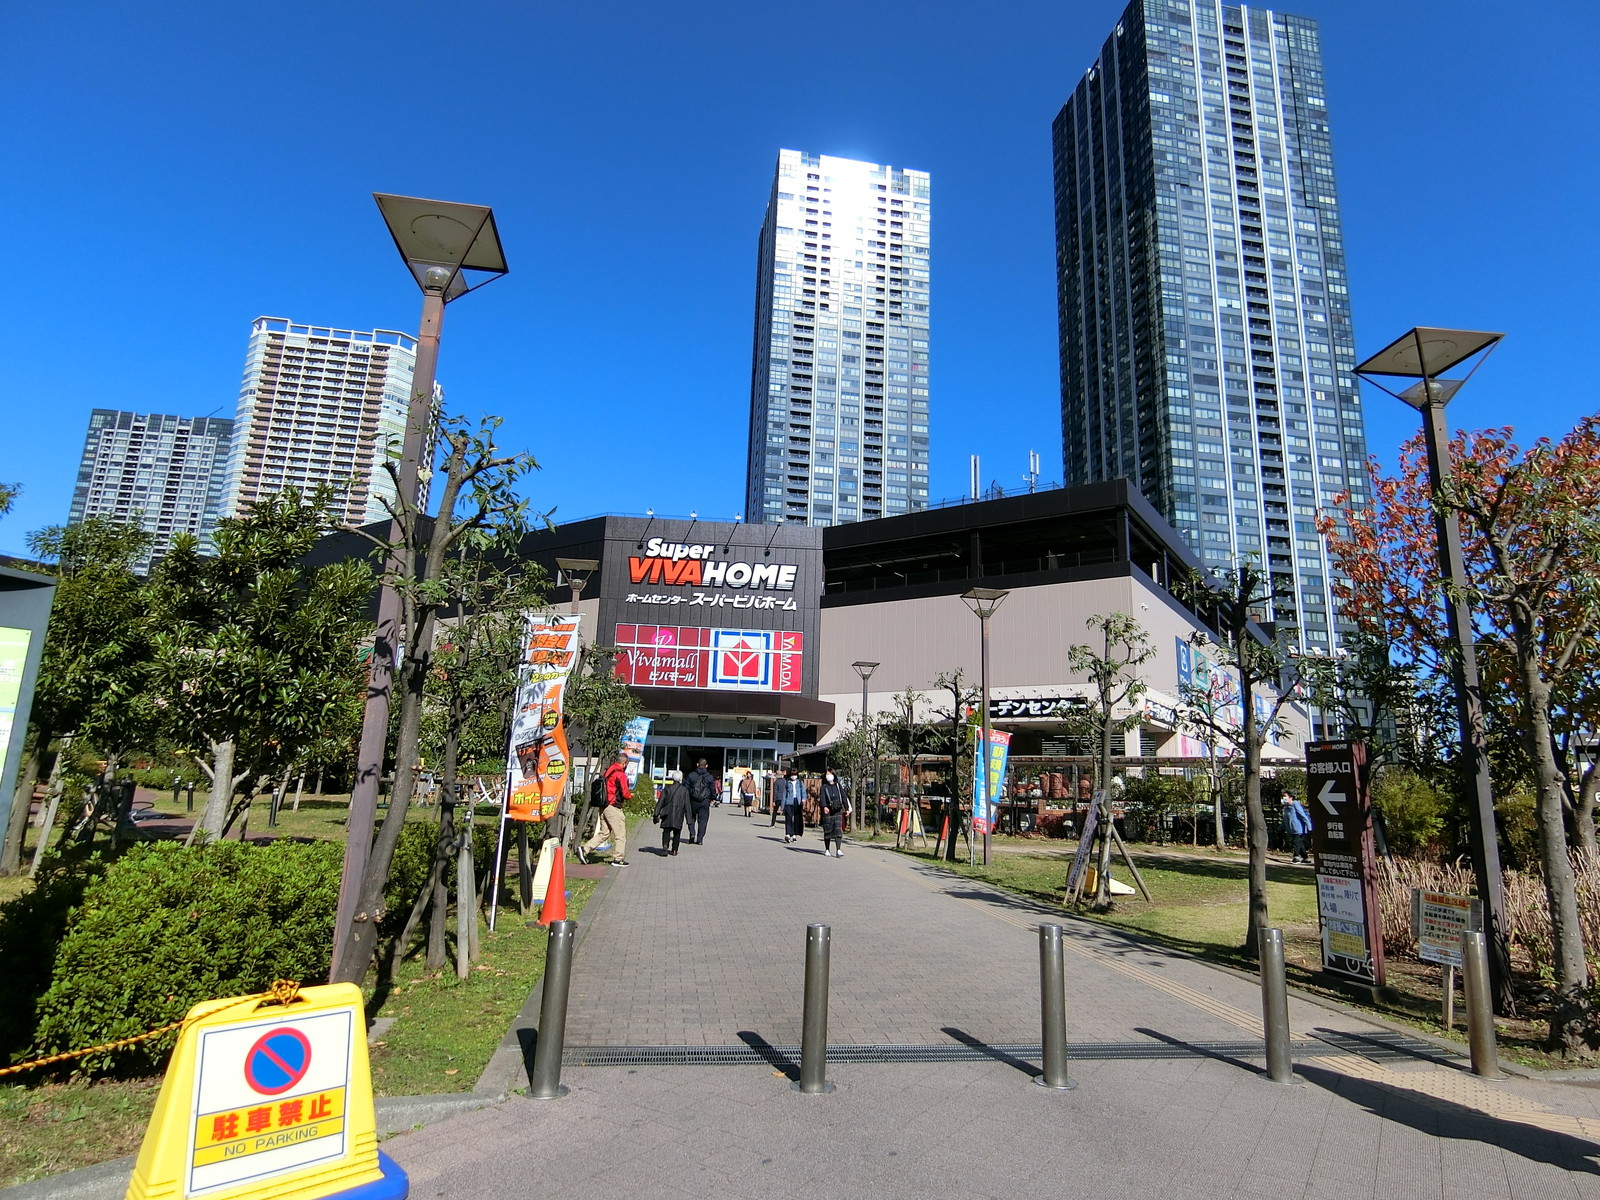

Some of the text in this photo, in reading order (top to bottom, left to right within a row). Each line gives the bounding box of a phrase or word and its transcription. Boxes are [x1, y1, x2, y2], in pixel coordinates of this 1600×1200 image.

[645, 537, 715, 561] Super
[625, 592, 797, 611] ホームセンター スーパービバホーム
[627, 650, 699, 669] Vivamall
[781, 636, 795, 688] YAMADA
[648, 671, 696, 682] ビバモール
[1309, 762, 1351, 774] お客様入口
[211, 1094, 332, 1142] 駐車禁止
[224, 1126, 319, 1157] NO PARKING
